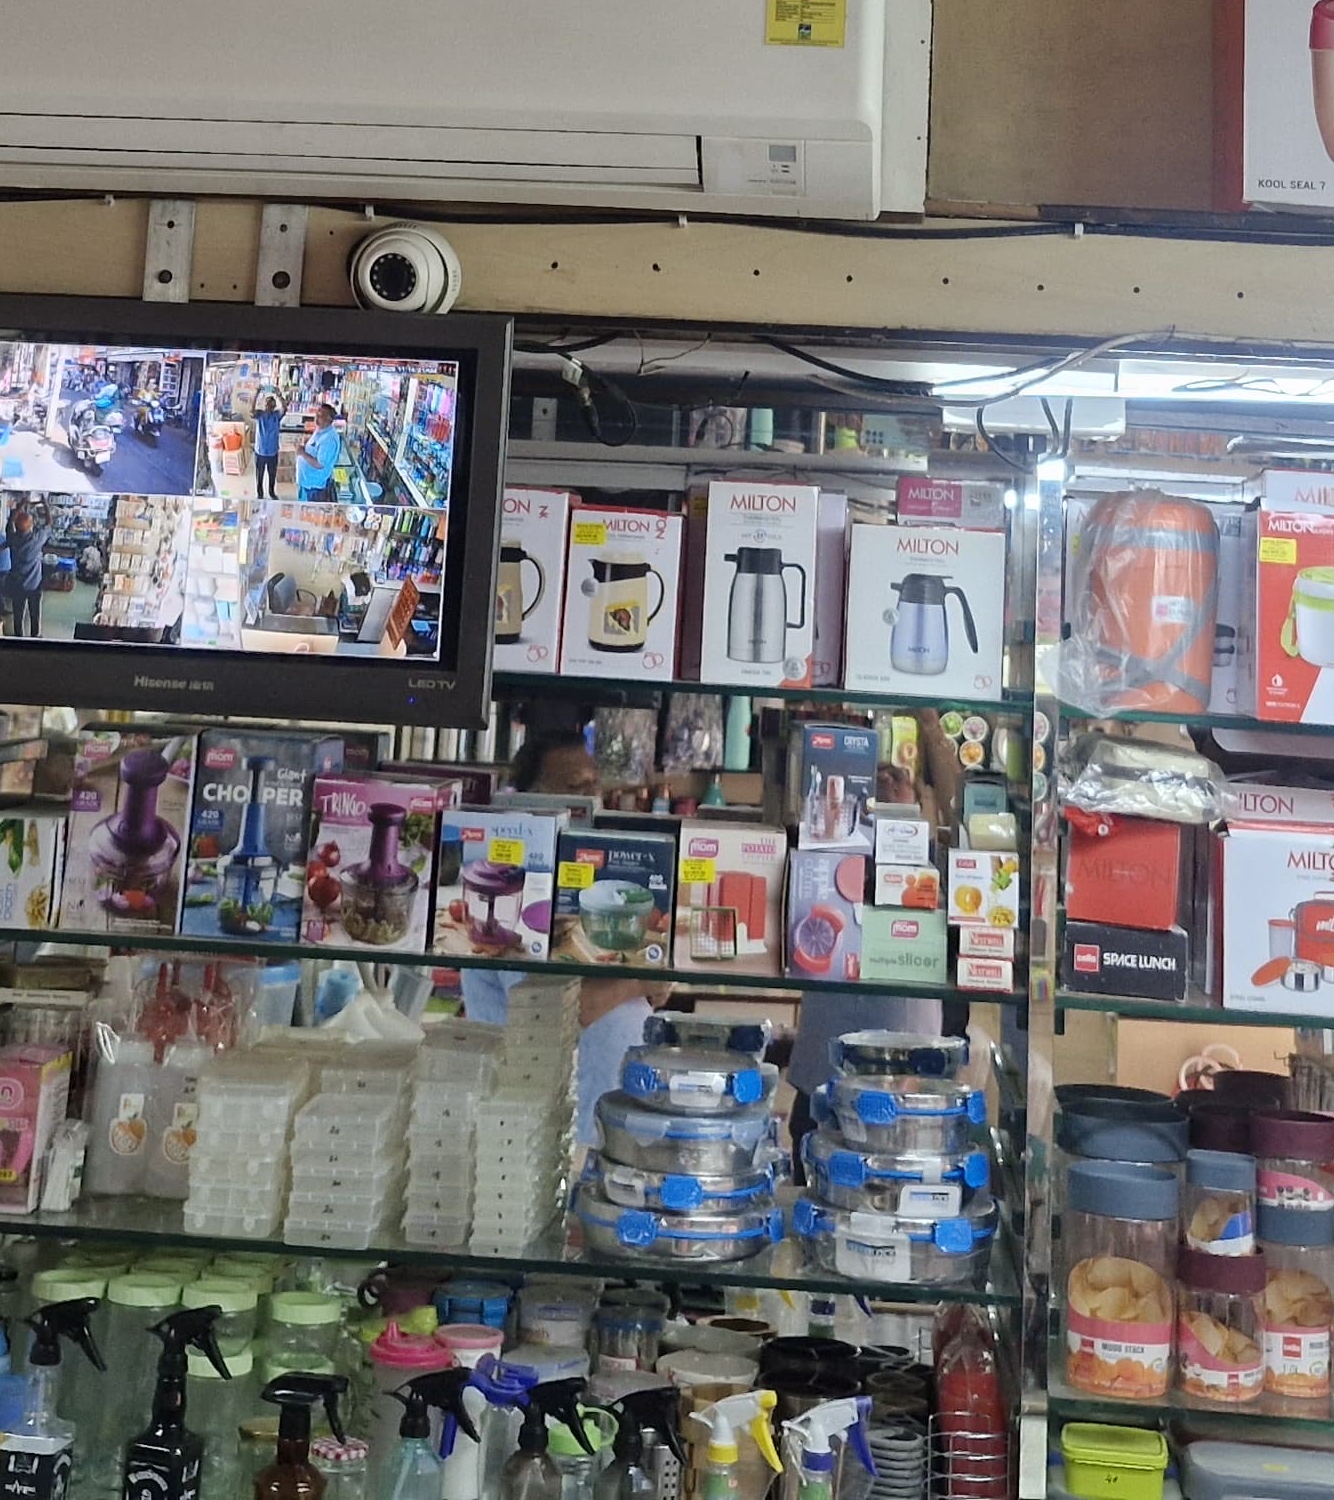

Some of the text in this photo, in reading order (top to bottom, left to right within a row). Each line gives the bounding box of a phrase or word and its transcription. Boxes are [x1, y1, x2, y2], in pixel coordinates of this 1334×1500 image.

[1257, 179, 1287, 190] KOOL
[1289, 180, 1317, 191] SEAL
[1320, 180, 1327, 190] 7
[908, 488, 954, 500] MILTON
[730, 493, 797, 513] MILTON
[1268, 520, 1314, 534] MILTON
[897, 539, 959, 555] MILTON
[134, 675, 186, 690] Hisense
[407, 679, 456, 691] LED TV
[79, 792, 97, 800] 420
[203, 783, 303, 806] CHOPER
[201, 810, 219, 819] 420
[691, 841, 717, 853] mom
[894, 923, 916, 932] mom
[898, 953, 939, 967] slicer
[1103, 952, 1138, 969] SPACE
[1138, 956, 1176, 972] LUNCH
